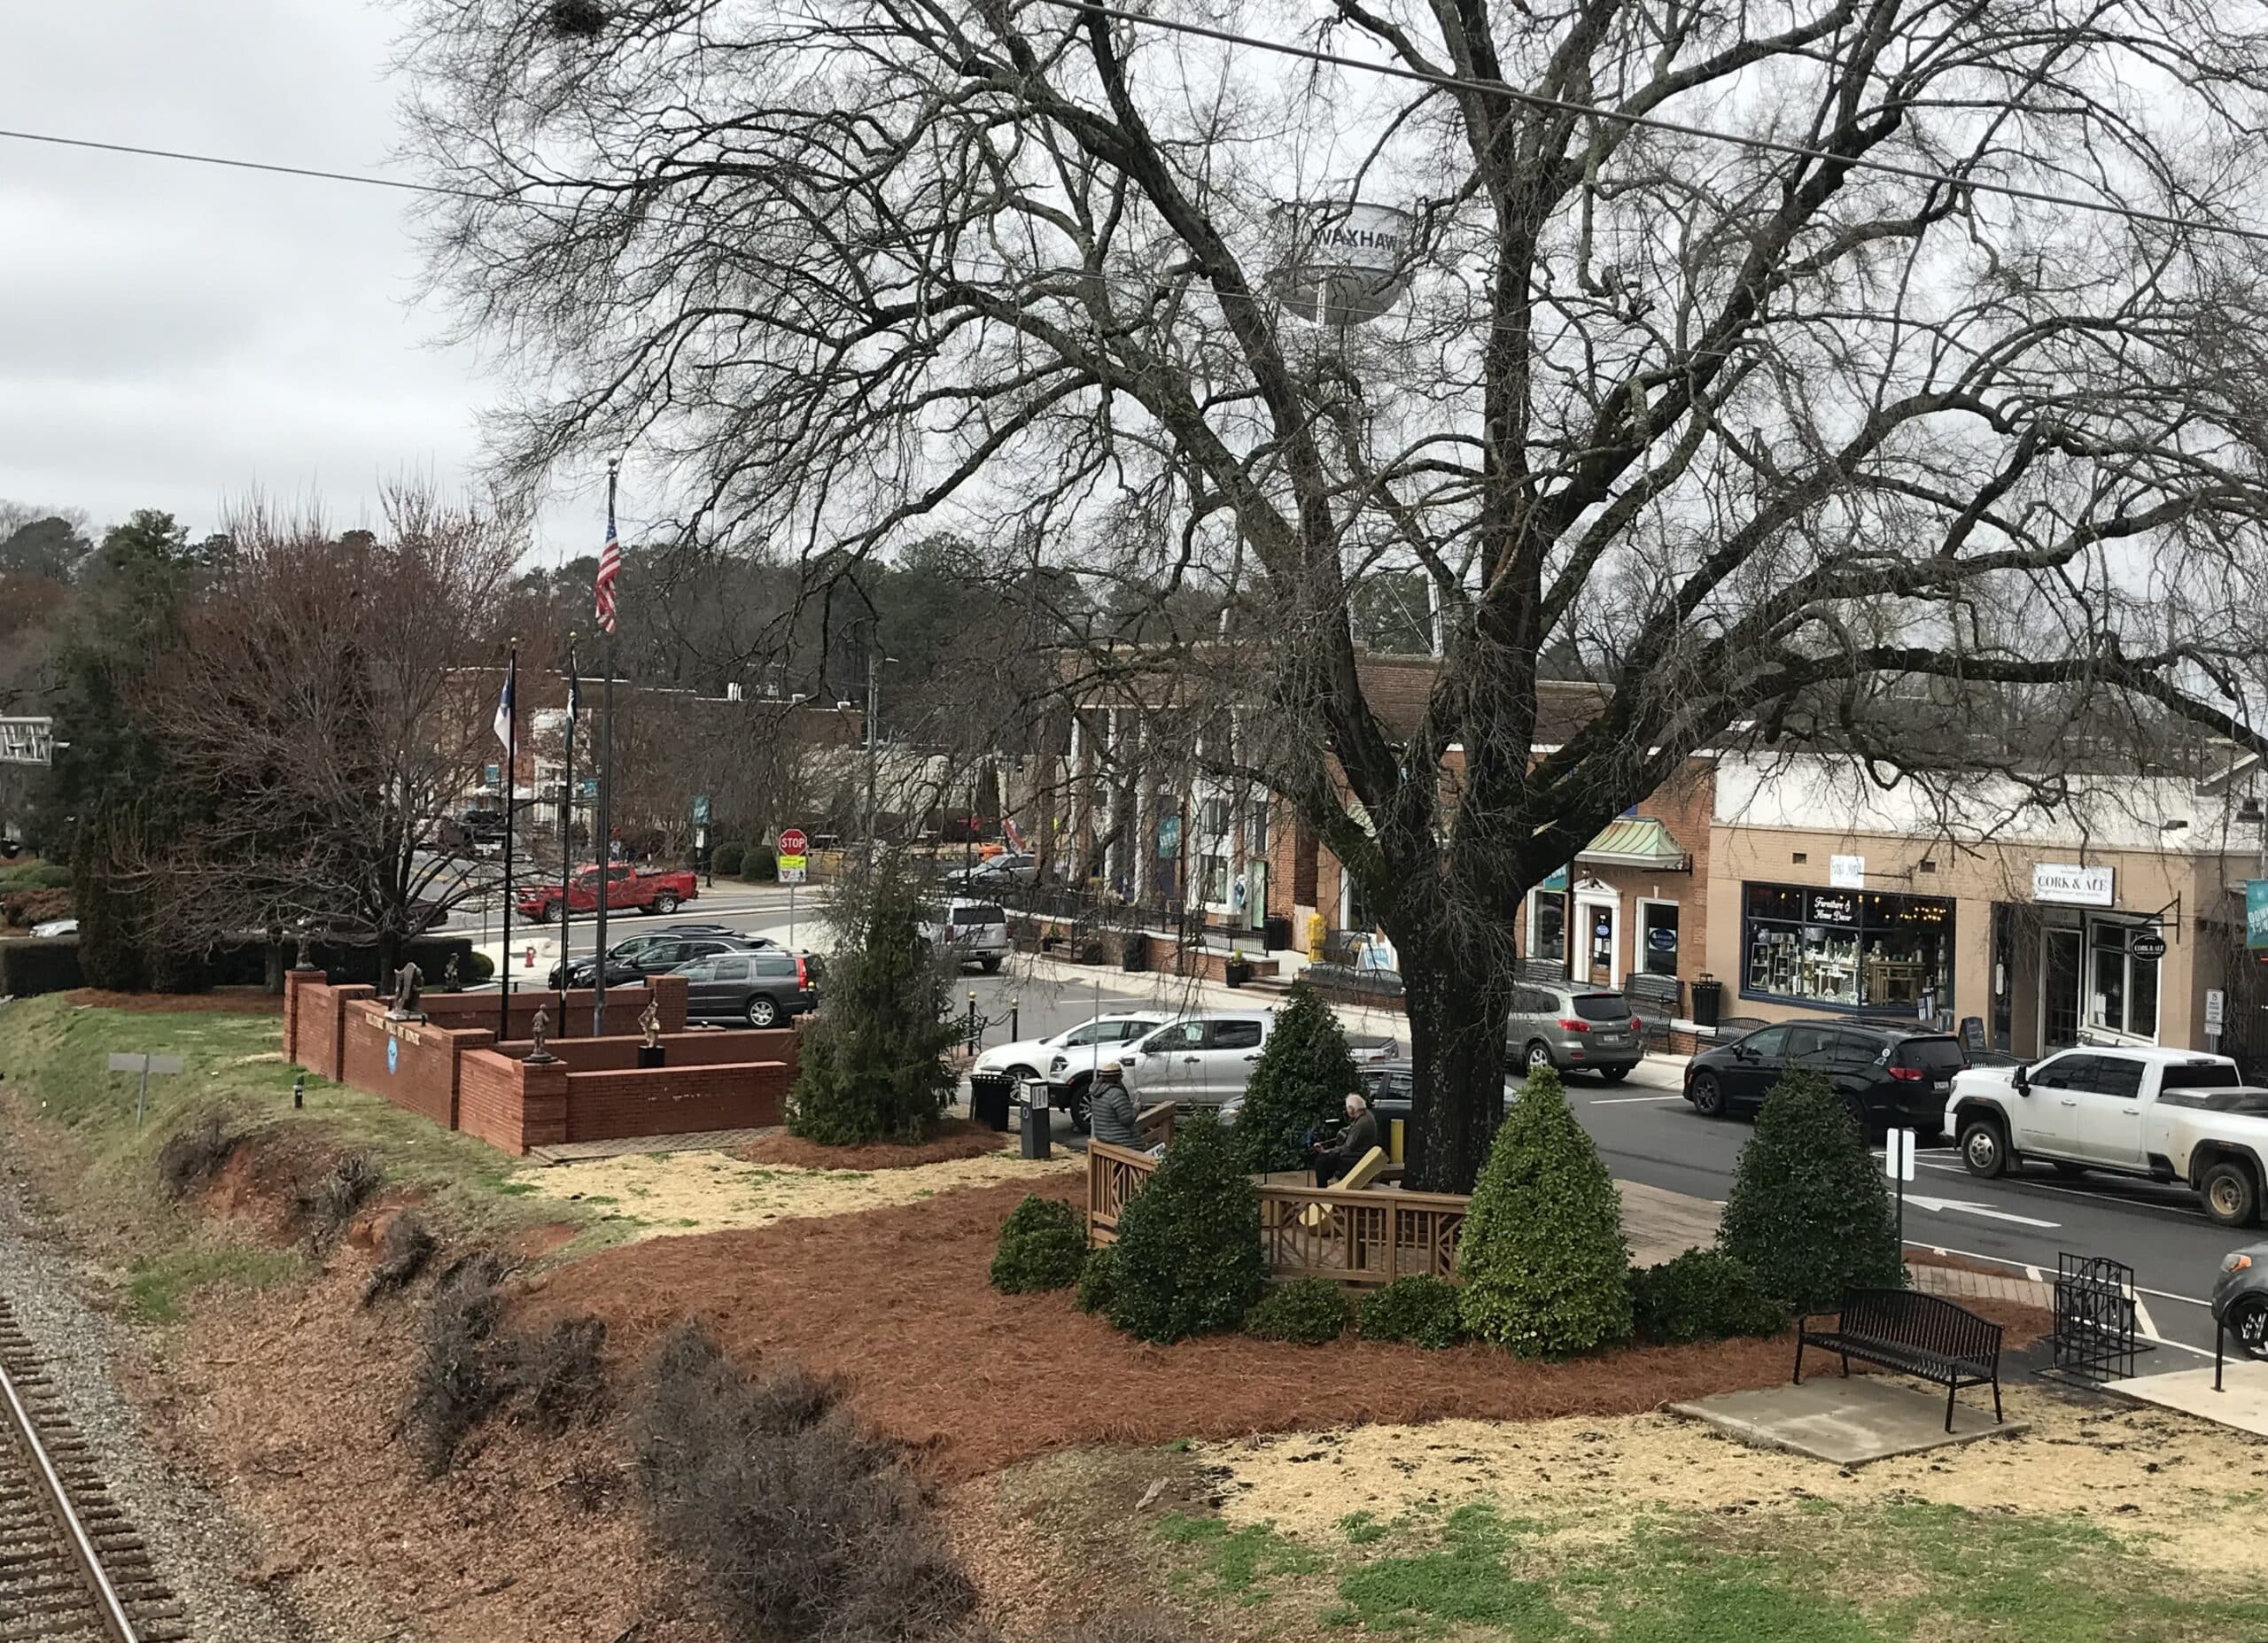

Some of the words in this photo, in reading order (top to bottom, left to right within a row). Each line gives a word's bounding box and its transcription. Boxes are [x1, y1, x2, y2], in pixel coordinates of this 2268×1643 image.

[1315, 229, 1397, 252] WAXHAW
[781, 837, 805, 849] STOP
[2038, 875, 2070, 889] CORK
[2072, 878, 2081, 890] &
